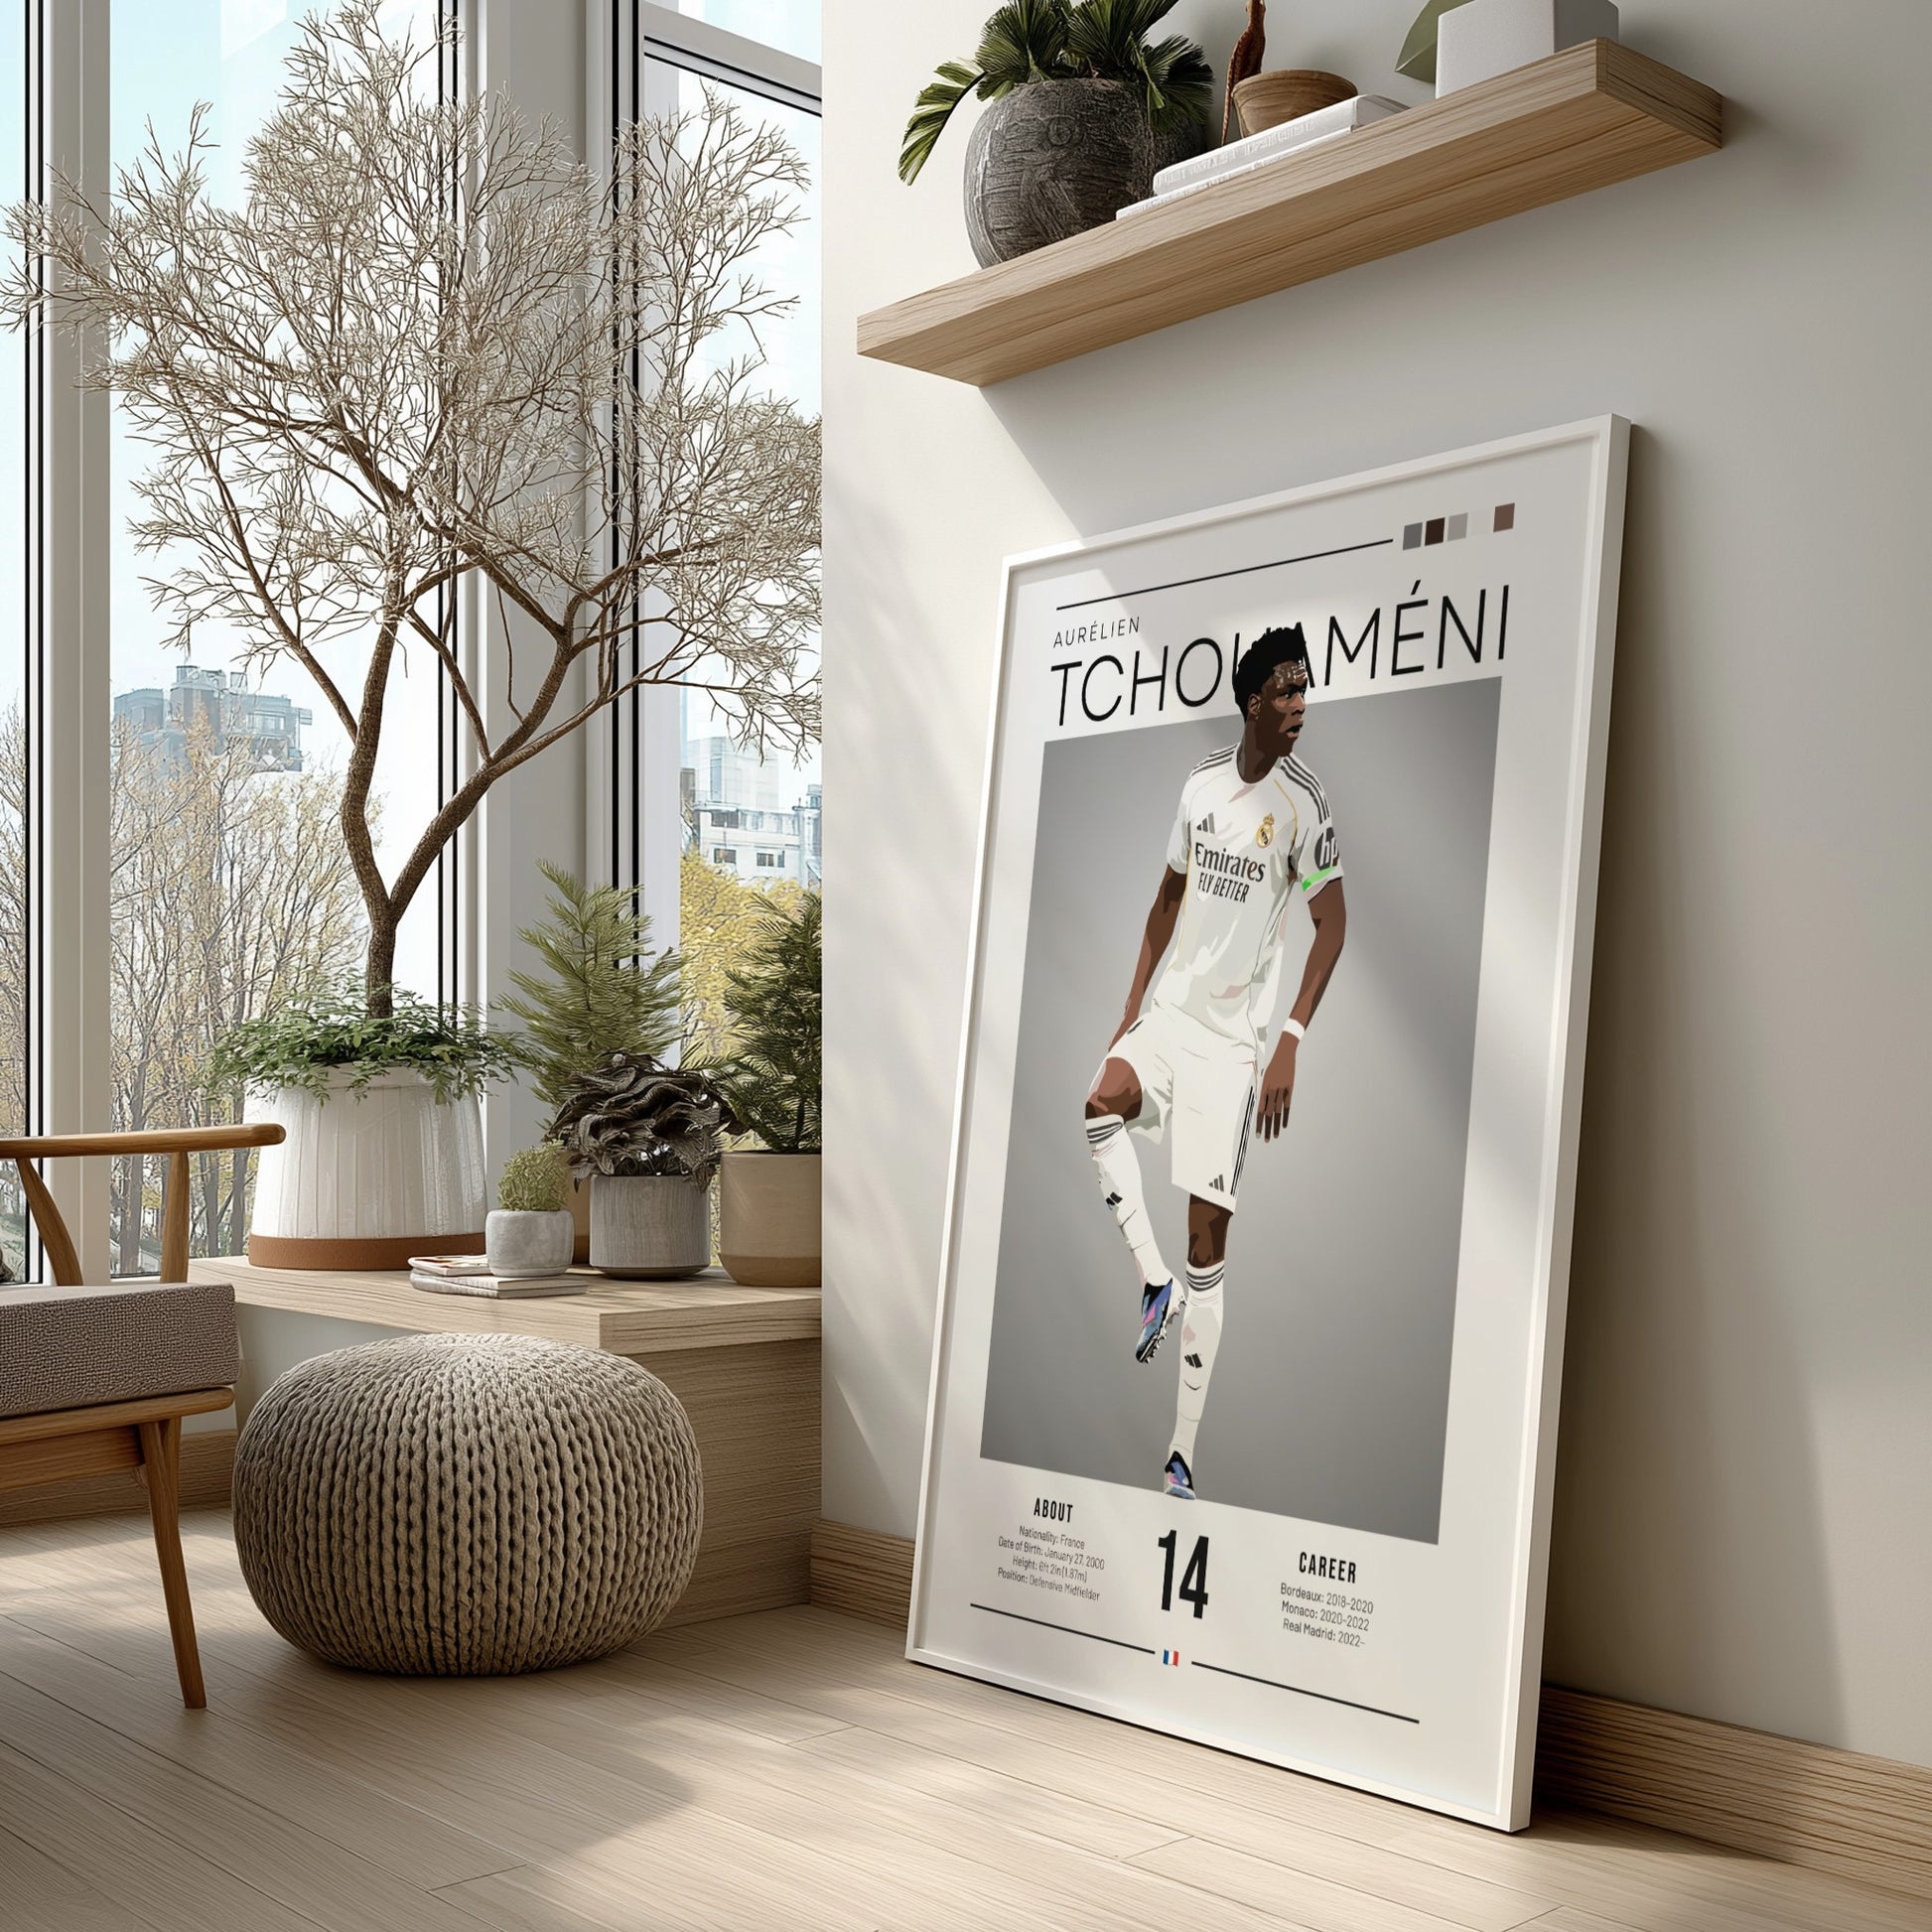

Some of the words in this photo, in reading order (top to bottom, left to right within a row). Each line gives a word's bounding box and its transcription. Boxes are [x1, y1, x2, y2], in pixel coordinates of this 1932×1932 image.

[1053, 616, 1140, 648] AURÉLIEN
[1195, 842, 1266, 883] Emirates
[1198, 872, 1214, 894] FLY
[1212, 876, 1250, 903] BETTER
[1034, 1497, 1074, 1524] ABOUT
[998, 1536, 1014, 1550] Date
[1015, 1540, 1024, 1551] of
[1024, 1542, 1043, 1556] Birth:
[1044, 1548, 1074, 1565] January
[1086, 1556, 1105, 1571] 2000
[1019, 1525, 1059, 1546] Nationality:
[1060, 1534, 1086, 1550] France
[1013, 1555, 1037, 1571] Height:
[1038, 1562, 1049, 1574] 6ft
[1158, 1529, 1209, 1619] 14
[1299, 1551, 1357, 1584] CAREER
[998, 1567, 1029, 1585] Position:
[1030, 1574, 1063, 1592] Defensive
[1064, 1584, 1100, 1601] Midfielder
[1281, 1582, 1324, 1603] Bordeaux:
[1326, 1592, 1374, 1614] 2018-2020
[1282, 1600, 1318, 1619] Monaco:
[1319, 1608, 1370, 1631] 2020-2022
[1283, 1618, 1303, 1633] Real
[1304, 1623, 1336, 1641] Madrid:
[1337, 1630, 1366, 1648] 2022-
